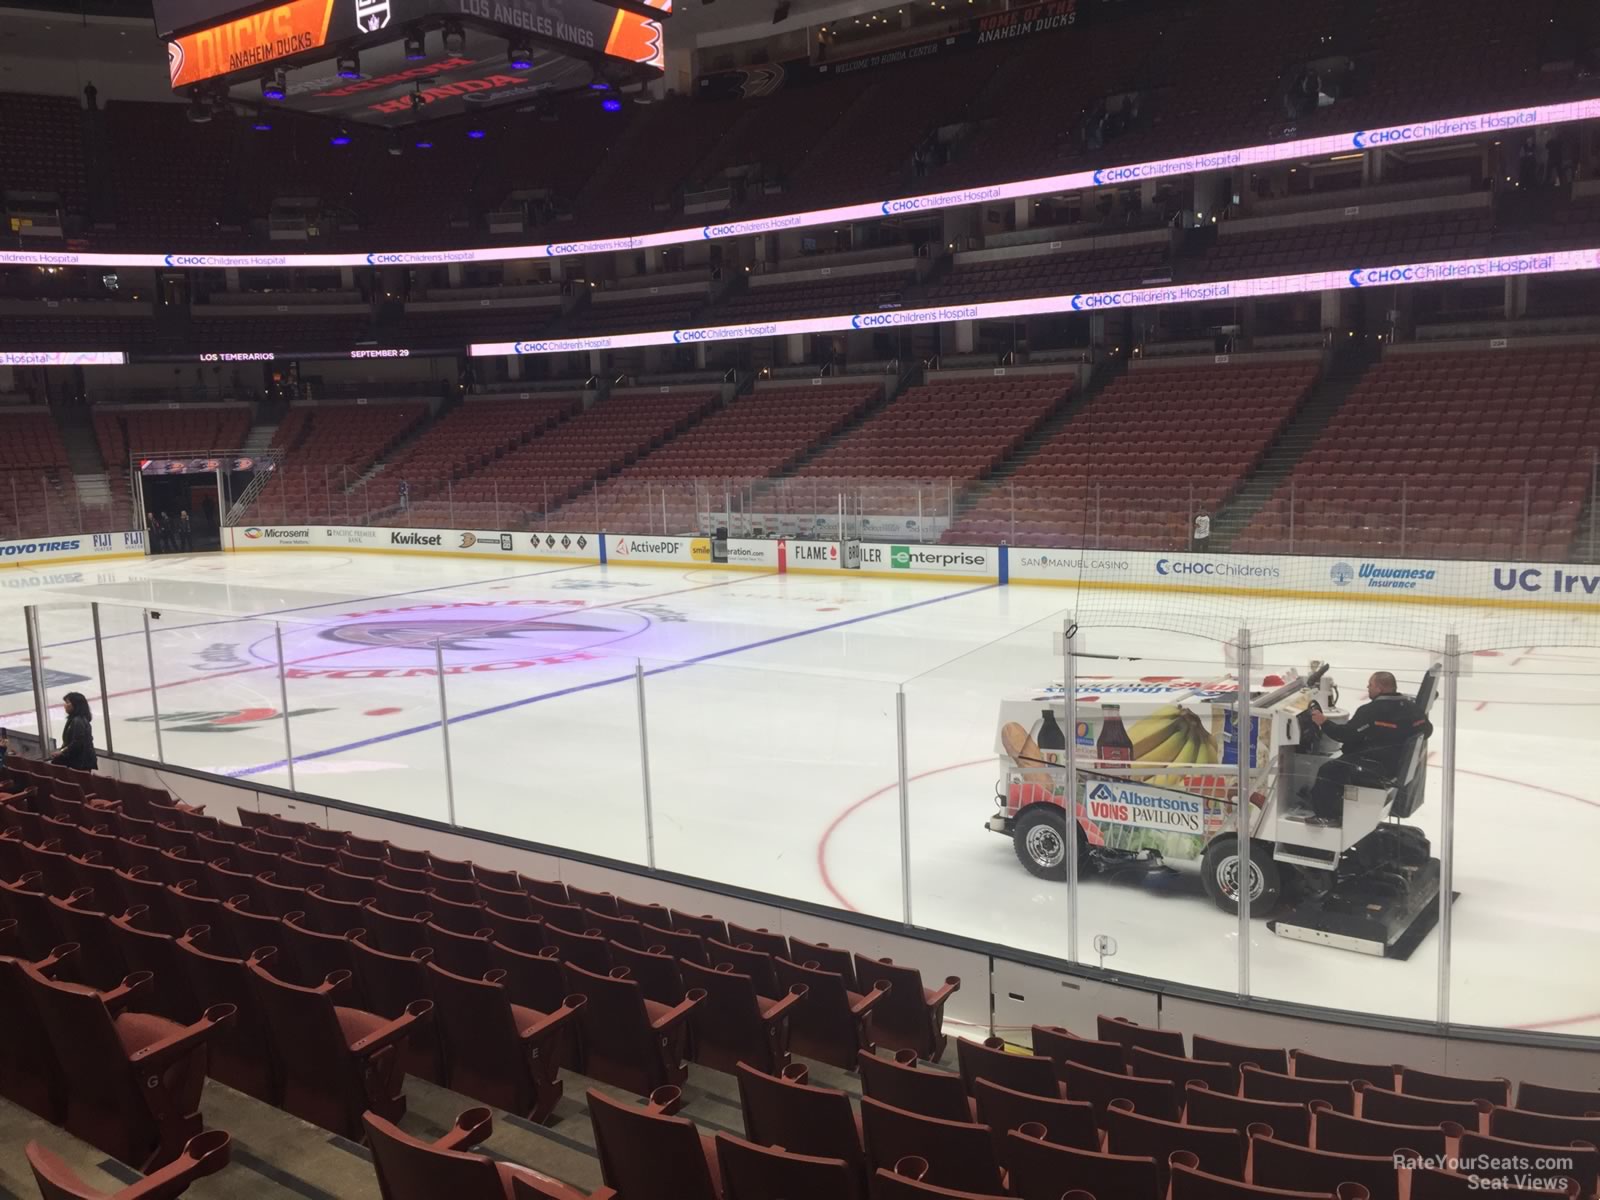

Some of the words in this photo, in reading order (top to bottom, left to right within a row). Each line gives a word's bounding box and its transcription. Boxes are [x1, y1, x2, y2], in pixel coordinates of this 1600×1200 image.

[461, 0, 490, 18] LOS
[494, 3, 553, 36] ANGELES
[556, 22, 594, 48] KINGS
[977, 22, 1032, 44] ANAHEIM
[1035, 12, 1076, 32] DUCKS
[229, 47, 273, 70] ANAHEIM
[277, 32, 312, 56] DUCKS
[368, 74, 528, 113] HONDA
[1370, 128, 1411, 144] CHOC
[1413, 120, 1477, 138] Children's
[1481, 110, 1537, 129] Hospital
[1107, 167, 1140, 181] CHOC
[1141, 161, 1193, 176] Children's
[1195, 153, 1240, 168] Hospital
[892, 199, 919, 211] CHOC
[920, 195, 962, 207] Children's
[964, 188, 1000, 201] Hospital
[712, 225, 734, 236] CHOC
[771, 216, 801, 227] Hospital
[555, 244, 578, 253] CHOC
[39, 254, 79, 264] Hospital
[177, 256, 207, 265] CHOC
[250, 256, 286, 266] Hospital
[377, 254, 403, 263] CHOC
[1367, 268, 1412, 283] CHOC
[1414, 263, 1485, 279] Children's
[1489, 256, 1551, 273] Hospital
[1085, 294, 1121, 307] CHOC
[1122, 290, 1177, 304] Children's
[1180, 284, 1229, 299] Hospital
[863, 314, 892, 326] CHOC
[892, 311, 936, 324] Children's
[939, 307, 977, 319] Hospital
[682, 330, 706, 341] CHOC
[707, 327, 743, 339] Children's
[744, 324, 776, 335] Hospital
[351, 350, 397, 358] SEPTEMBER
[399, 349, 410, 357] 29
[524, 342, 548, 352] CHOC
[6, 354, 49, 364] Hospital
[220, 352, 274, 361] TEMERARIOS
[93, 534, 112, 547] FIJI
[124, 532, 143, 545] FIJI
[264, 528, 309, 538] Microsemi
[391, 531, 442, 546] Kwikset
[0, 544, 36, 556] TOYO
[38, 540, 80, 553] TIRES
[630, 541, 680, 554] ActivePDF
[795, 545, 827, 561] FLAME
[897, 552, 985, 567] enterprise
[1021, 557, 1041, 567] SAN
[1048, 558, 1089, 569] MANUEL
[1091, 560, 1129, 570] CASINO
[1173, 562, 1214, 575] CHOC
[1216, 563, 1280, 578] Children's
[1359, 563, 1436, 580] Wawanesa
[1368, 578, 1416, 589] Insurance
[1494, 567, 1542, 592] UC
[1118, 790, 1199, 813] Albertsons
[1091, 801, 1128, 821] VONS
[1132, 807, 1199, 831] PAVILIONS
[146, 1075, 159, 1089] G
